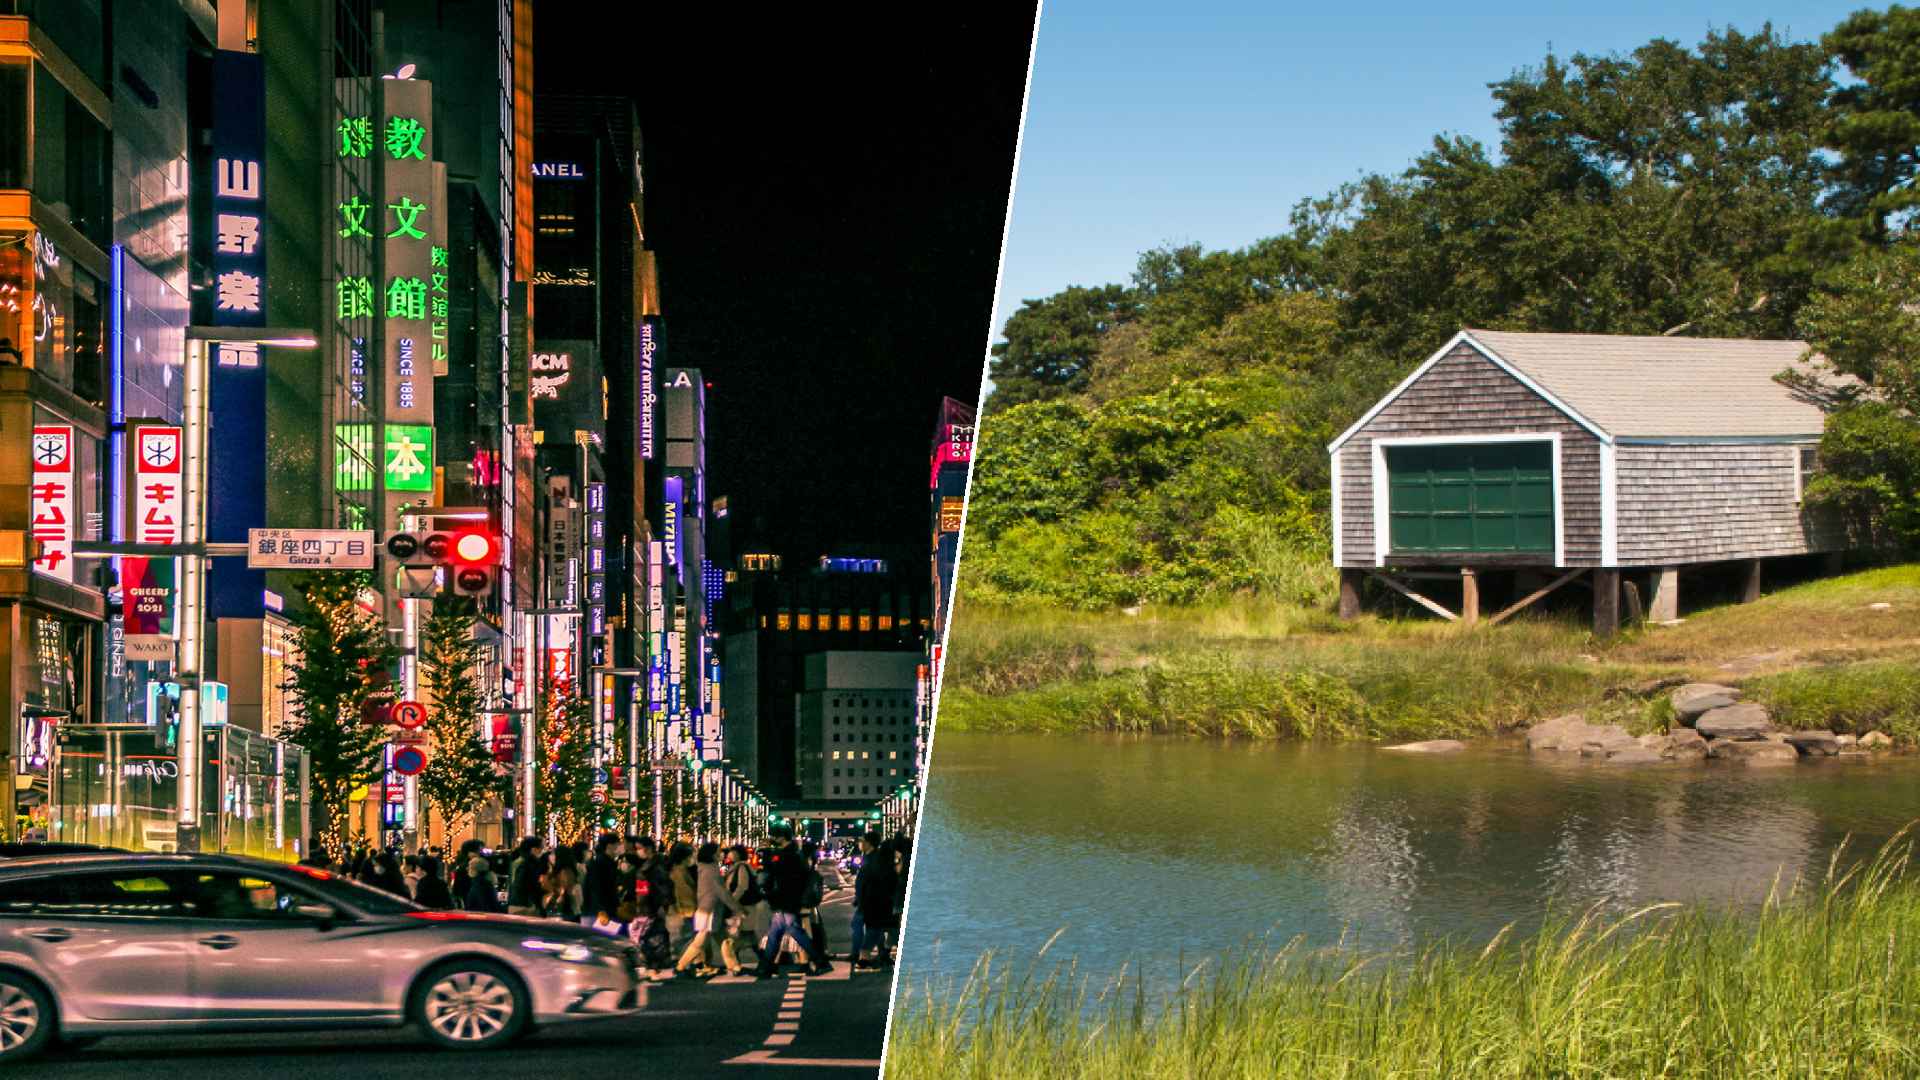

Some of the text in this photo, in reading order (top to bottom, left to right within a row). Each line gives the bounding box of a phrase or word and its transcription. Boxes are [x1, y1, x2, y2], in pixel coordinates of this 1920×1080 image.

[384, 116, 428, 320] 教文館
[432, 245, 449, 361] 教文館ビル
[400, 338, 413, 408] SINCE 1885
[387, 436, 426, 480] 本
[258, 530, 291, 538] 中央区
[258, 539, 364, 556] 銀座四丁目
[289, 555, 332, 564] Ginza 4
[130, 587, 169, 596] CHEERS
[137, 604, 162, 612] 2021
[132, 642, 168, 652] WAKO
